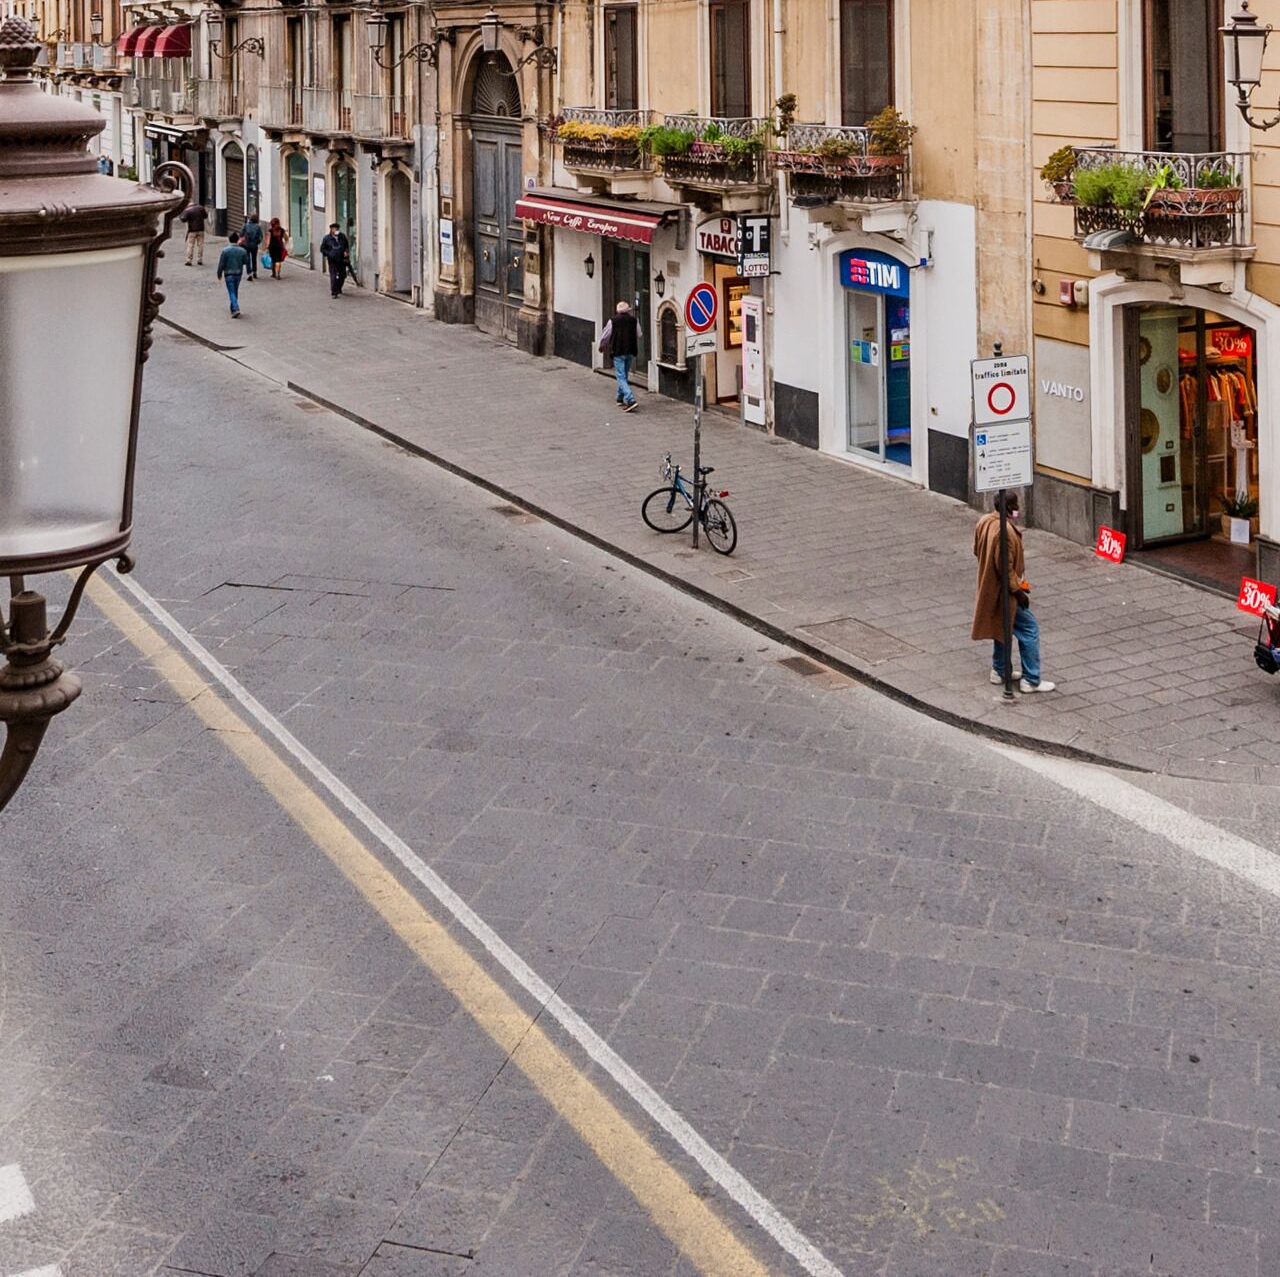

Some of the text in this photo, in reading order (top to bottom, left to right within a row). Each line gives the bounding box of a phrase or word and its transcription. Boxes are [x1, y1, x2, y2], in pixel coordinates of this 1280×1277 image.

[543, 211, 561, 222] New
[587, 218, 618, 233] Europeo
[699, 231, 738, 255] TABAC
[746, 218, 768, 252] T
[744, 263, 769, 273] LOTTO
[866, 261, 901, 289] TIM
[1215, 336, 1247, 352] 30%
[975, 368, 1026, 380] traffico limitato
[1041, 379, 1084, 402] VANTO
[1099, 531, 1121, 555] 30%
[1241, 587, 1270, 609] 30%
